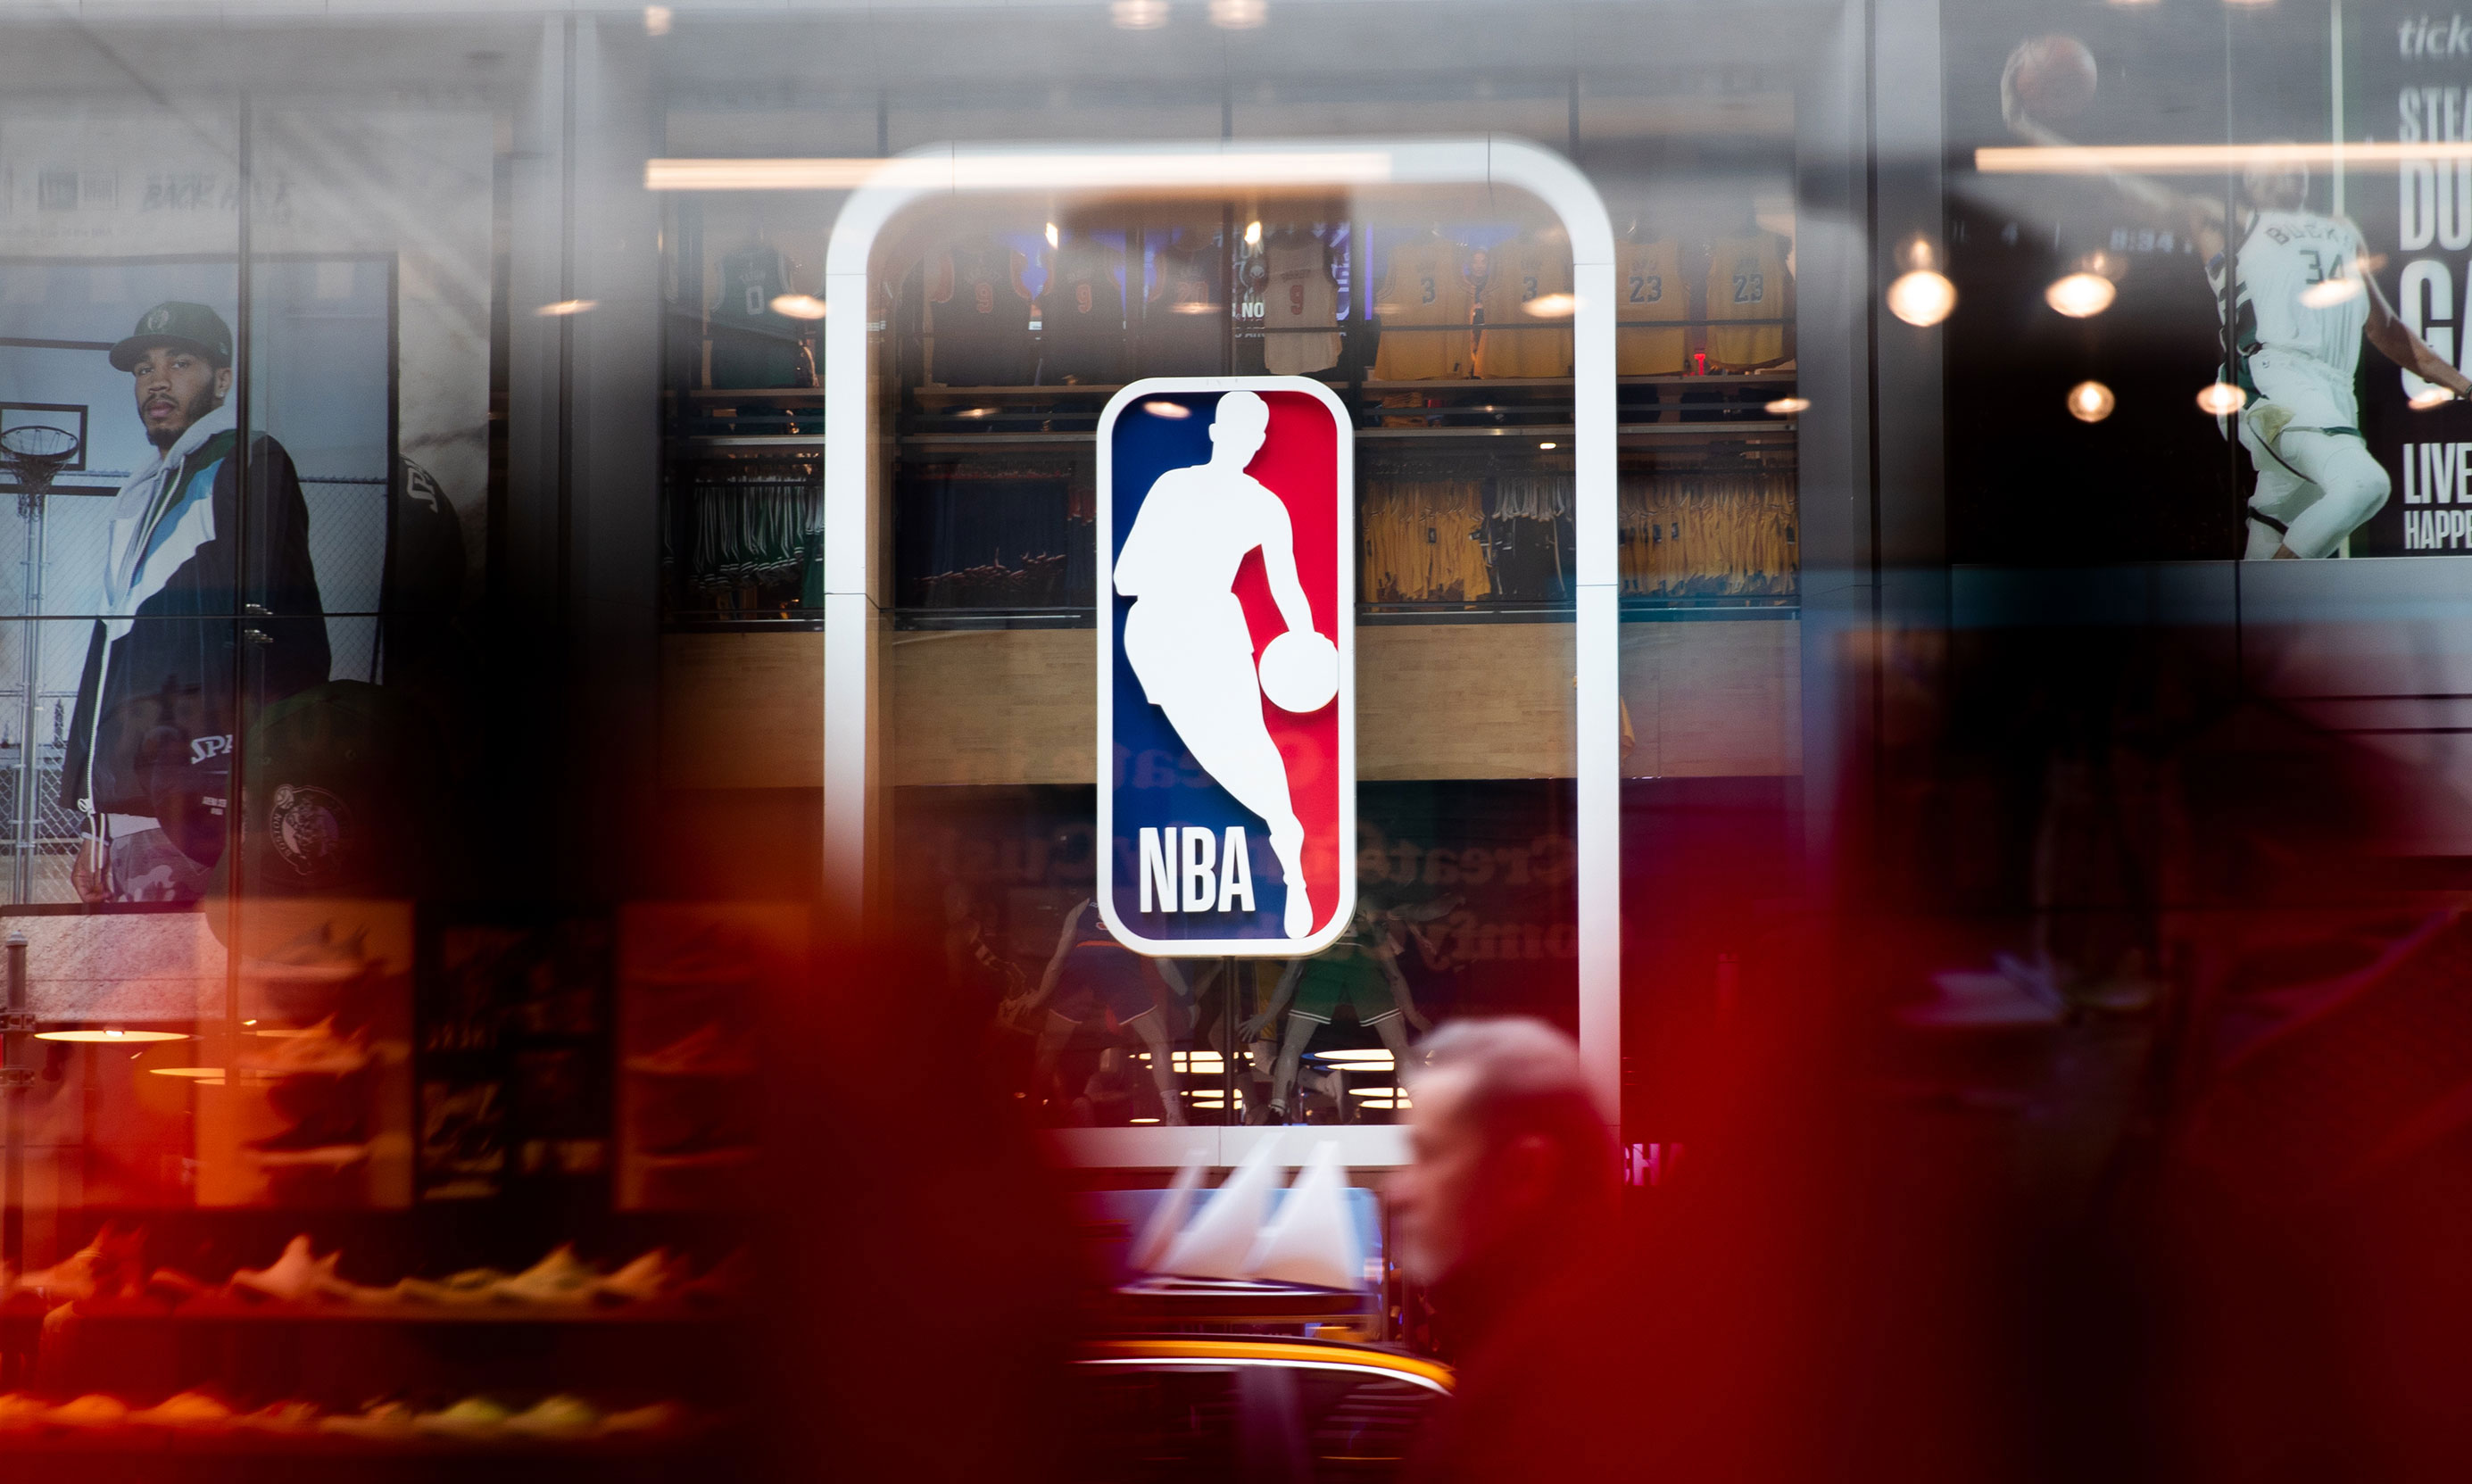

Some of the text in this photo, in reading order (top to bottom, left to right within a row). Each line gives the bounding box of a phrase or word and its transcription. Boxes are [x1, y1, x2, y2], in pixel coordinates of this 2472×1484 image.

[2398, 12, 2472, 57] tick
[1290, 284, 1305, 316] 9
[1420, 276, 1437, 305] 3
[1628, 275, 1663, 303] 23
[1731, 273, 1765, 303] 23
[2403, 442, 2472, 505] LIVE
[1139, 825, 1257, 914] NBA
